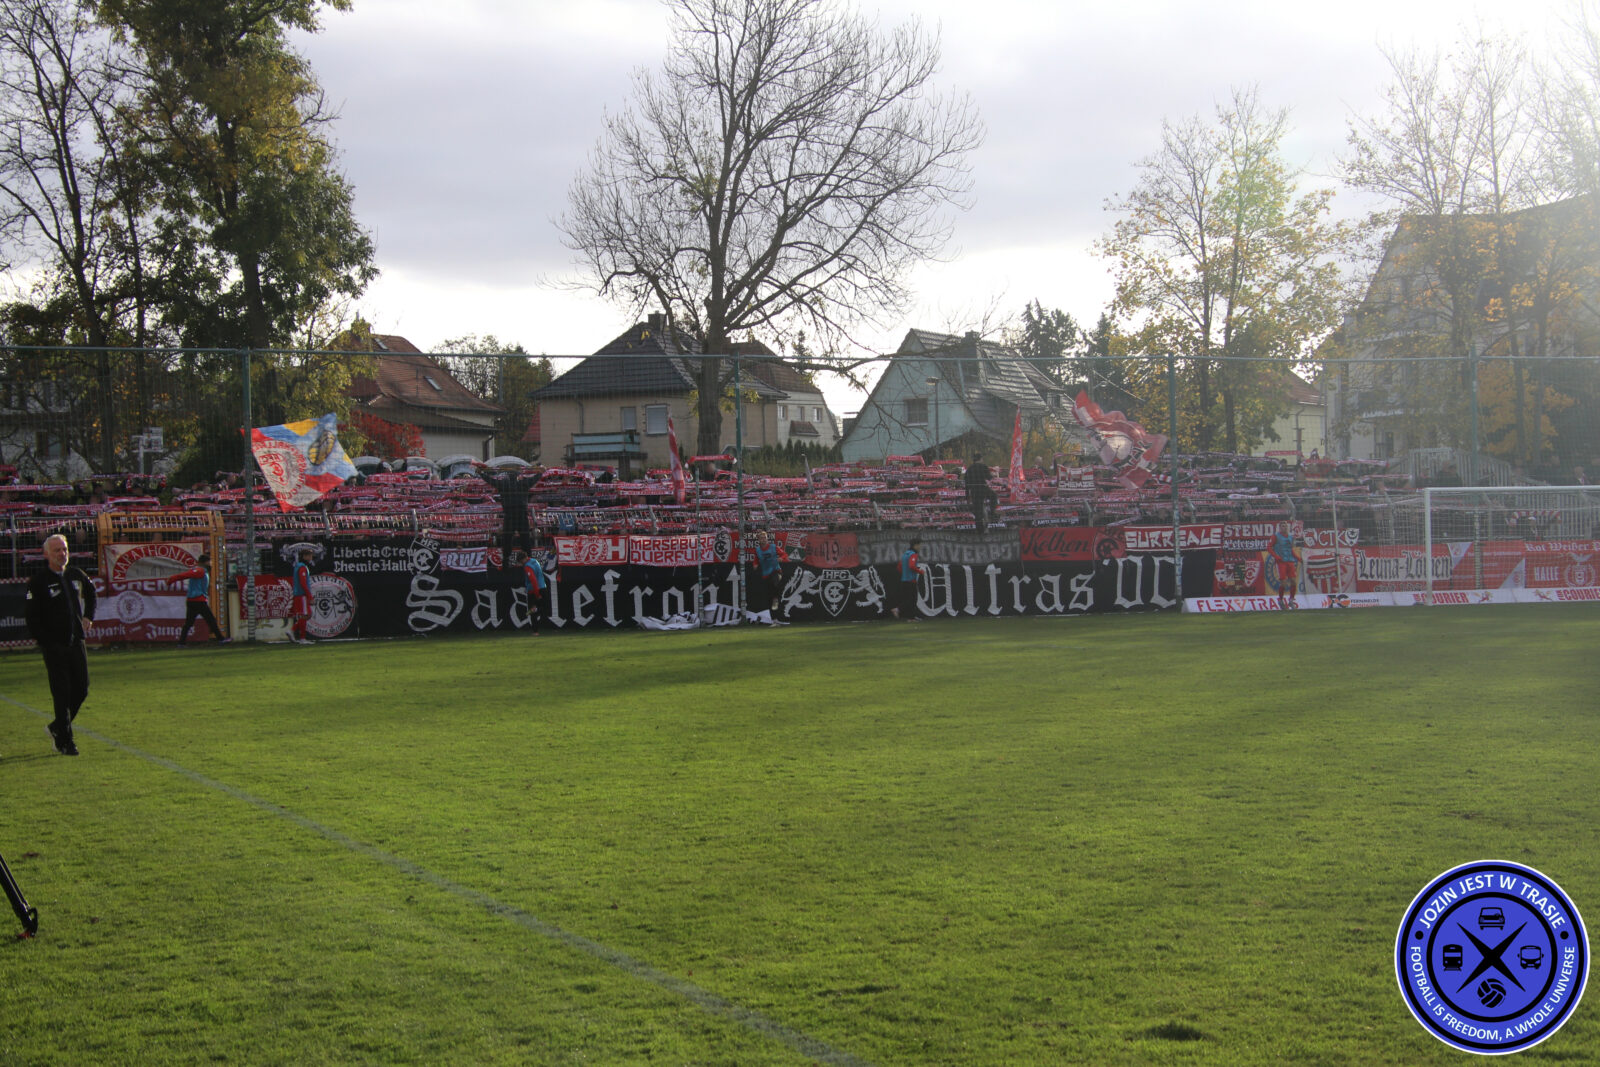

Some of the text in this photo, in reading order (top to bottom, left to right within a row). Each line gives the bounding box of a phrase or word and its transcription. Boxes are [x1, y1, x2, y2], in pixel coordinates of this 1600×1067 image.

[742, 532, 776, 540] SEKON
[1124, 528, 1222, 549] SURREALE
[419, 538, 440, 550] HFC
[734, 539, 783, 549] MANSD
[1222, 539, 1271, 550] Petersber
[857, 540, 1021, 566] STAONVERBOT
[333, 559, 413, 573] Chemie Halle
[825, 570, 848, 580] HFC
[1533, 566, 1559, 581] HALLE
[916, 562, 1095, 617] Ultras
